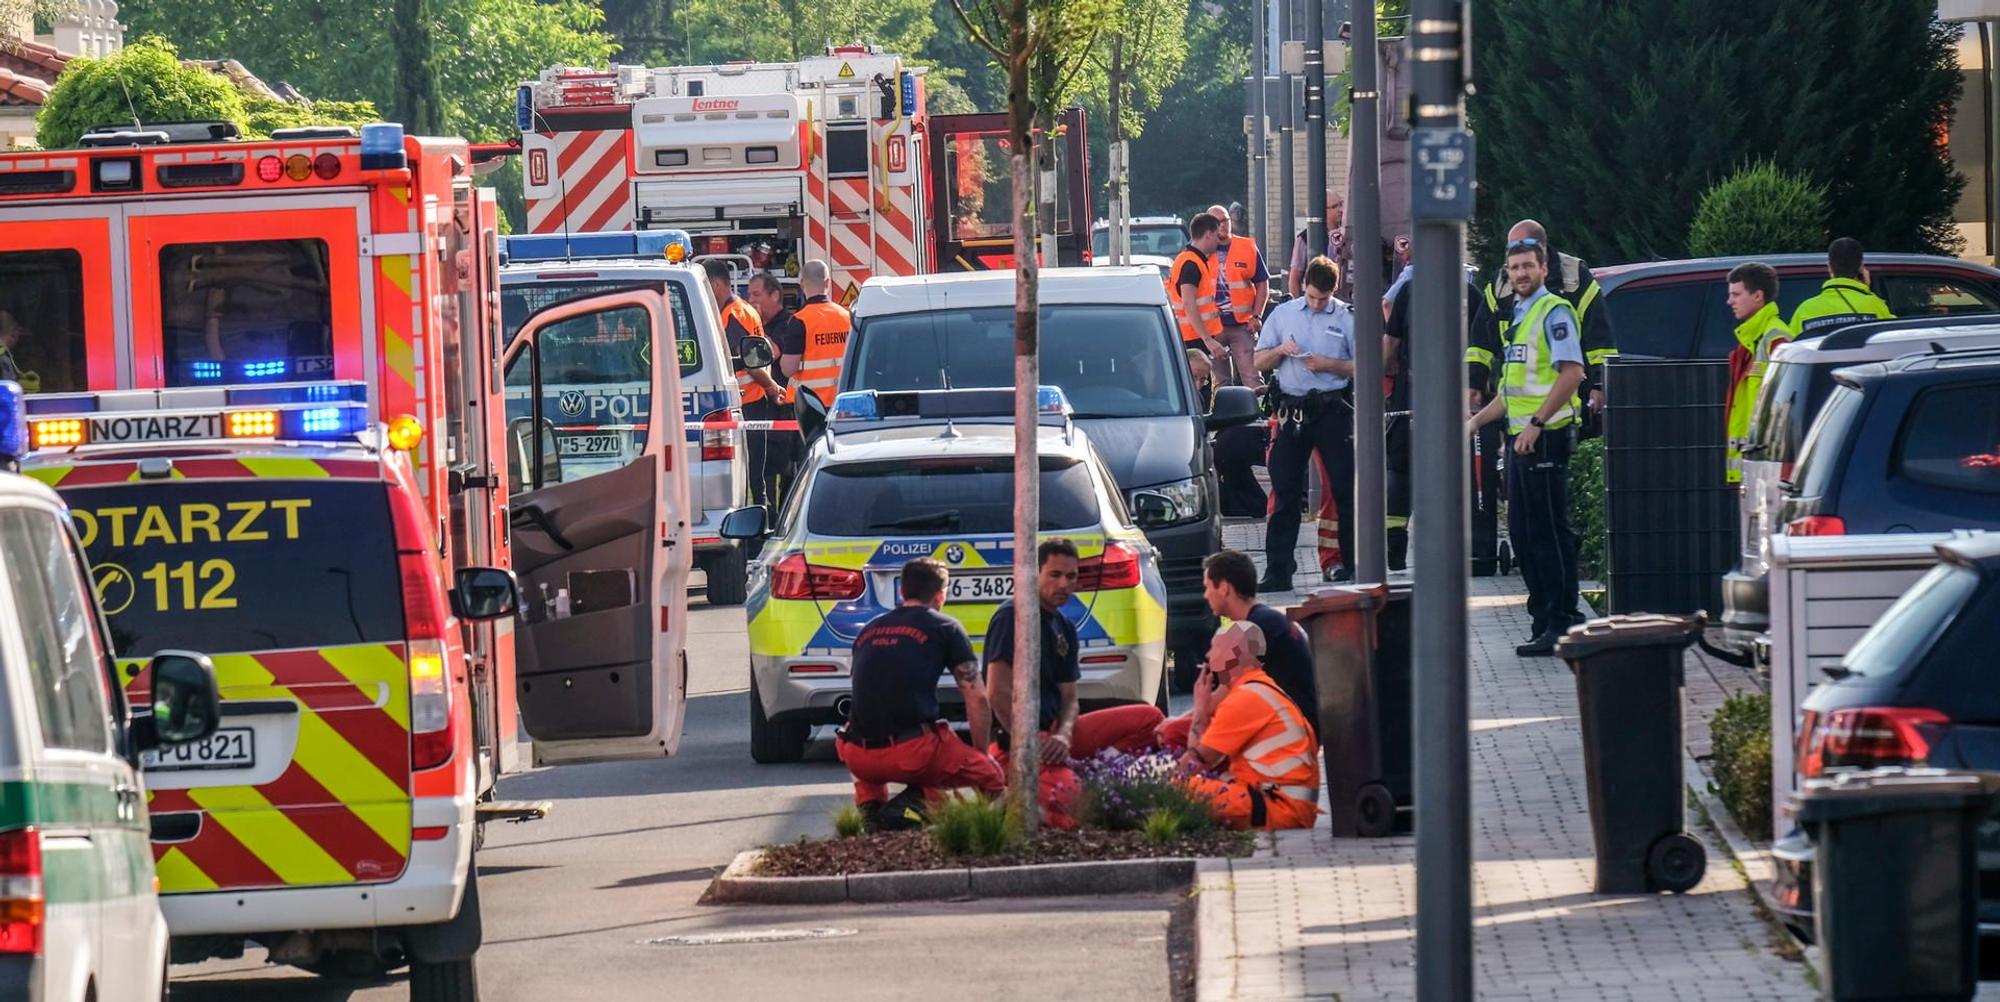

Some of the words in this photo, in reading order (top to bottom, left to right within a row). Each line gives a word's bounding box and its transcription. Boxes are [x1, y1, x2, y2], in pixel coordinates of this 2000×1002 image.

[814, 331, 849, 345] FEUERW
[590, 391, 699, 418] POLEI
[92, 415, 219, 441] NOTARZT
[70, 499, 312, 548] OTARZT
[883, 543, 932, 555] POLIZEI
[142, 558, 238, 611] 112
[198, 734, 248, 760] 821
